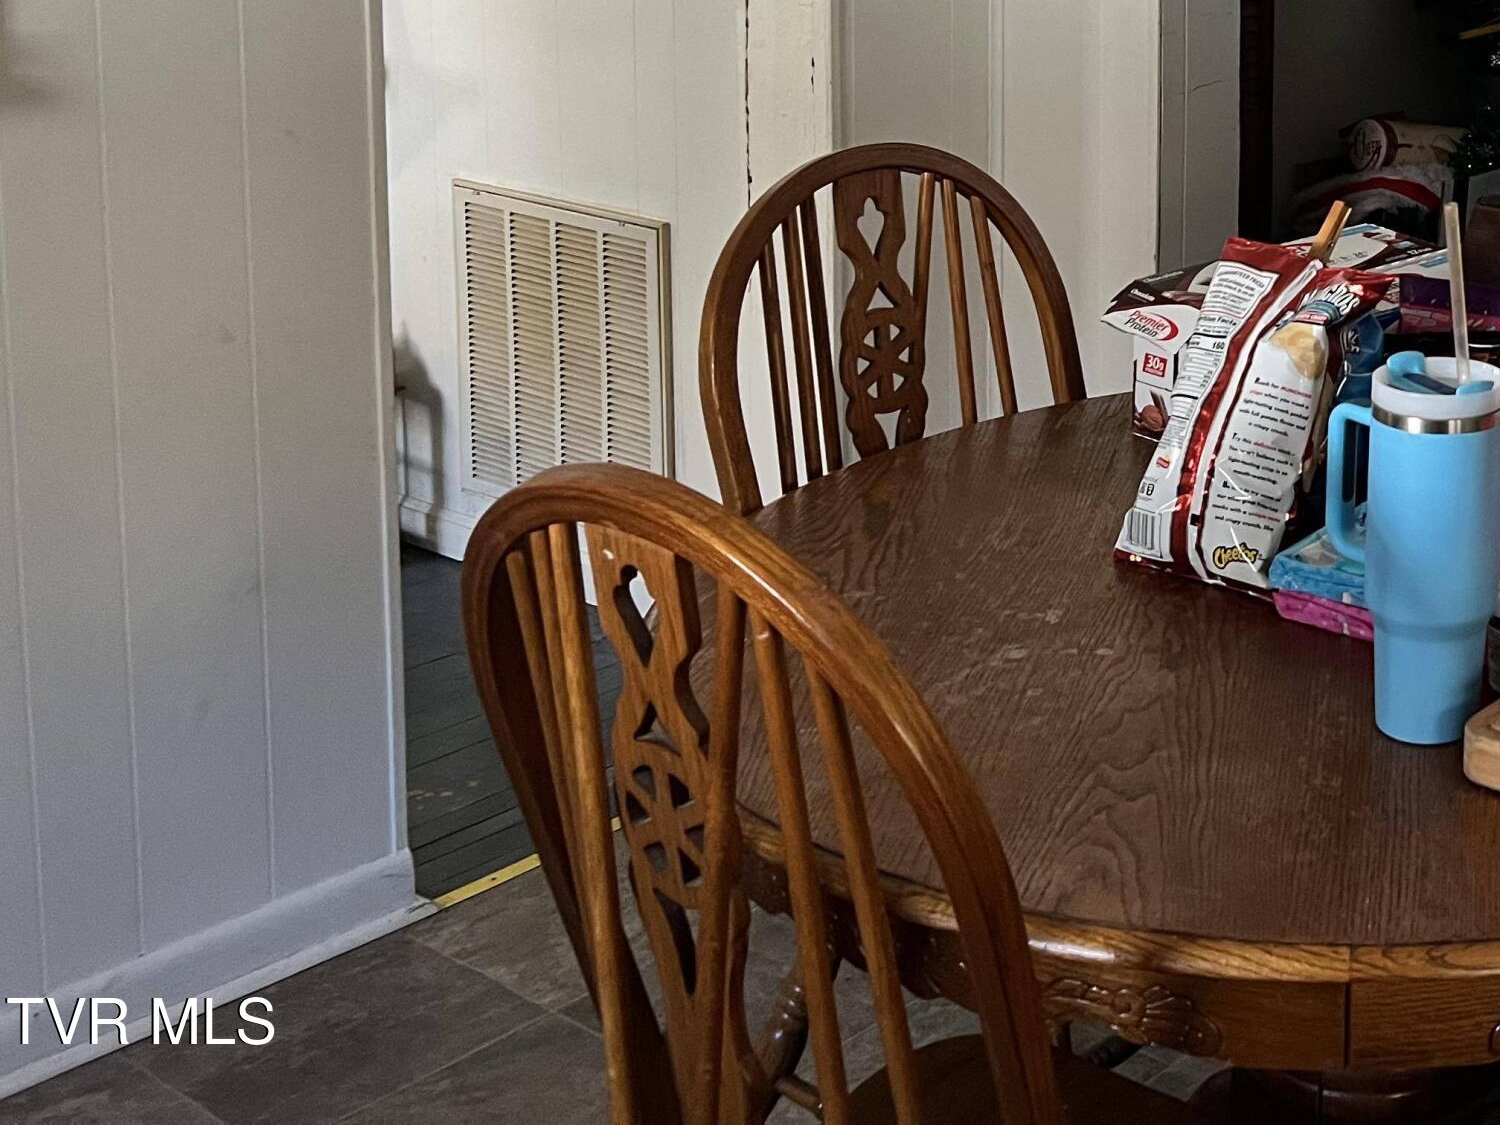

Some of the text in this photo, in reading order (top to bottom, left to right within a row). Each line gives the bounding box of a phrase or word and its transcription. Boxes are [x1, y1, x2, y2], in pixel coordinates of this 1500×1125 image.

[1124, 317, 1159, 338] Protein
[1130, 310, 1167, 331] Premier
[1213, 543, 1259, 568] Cheetos
